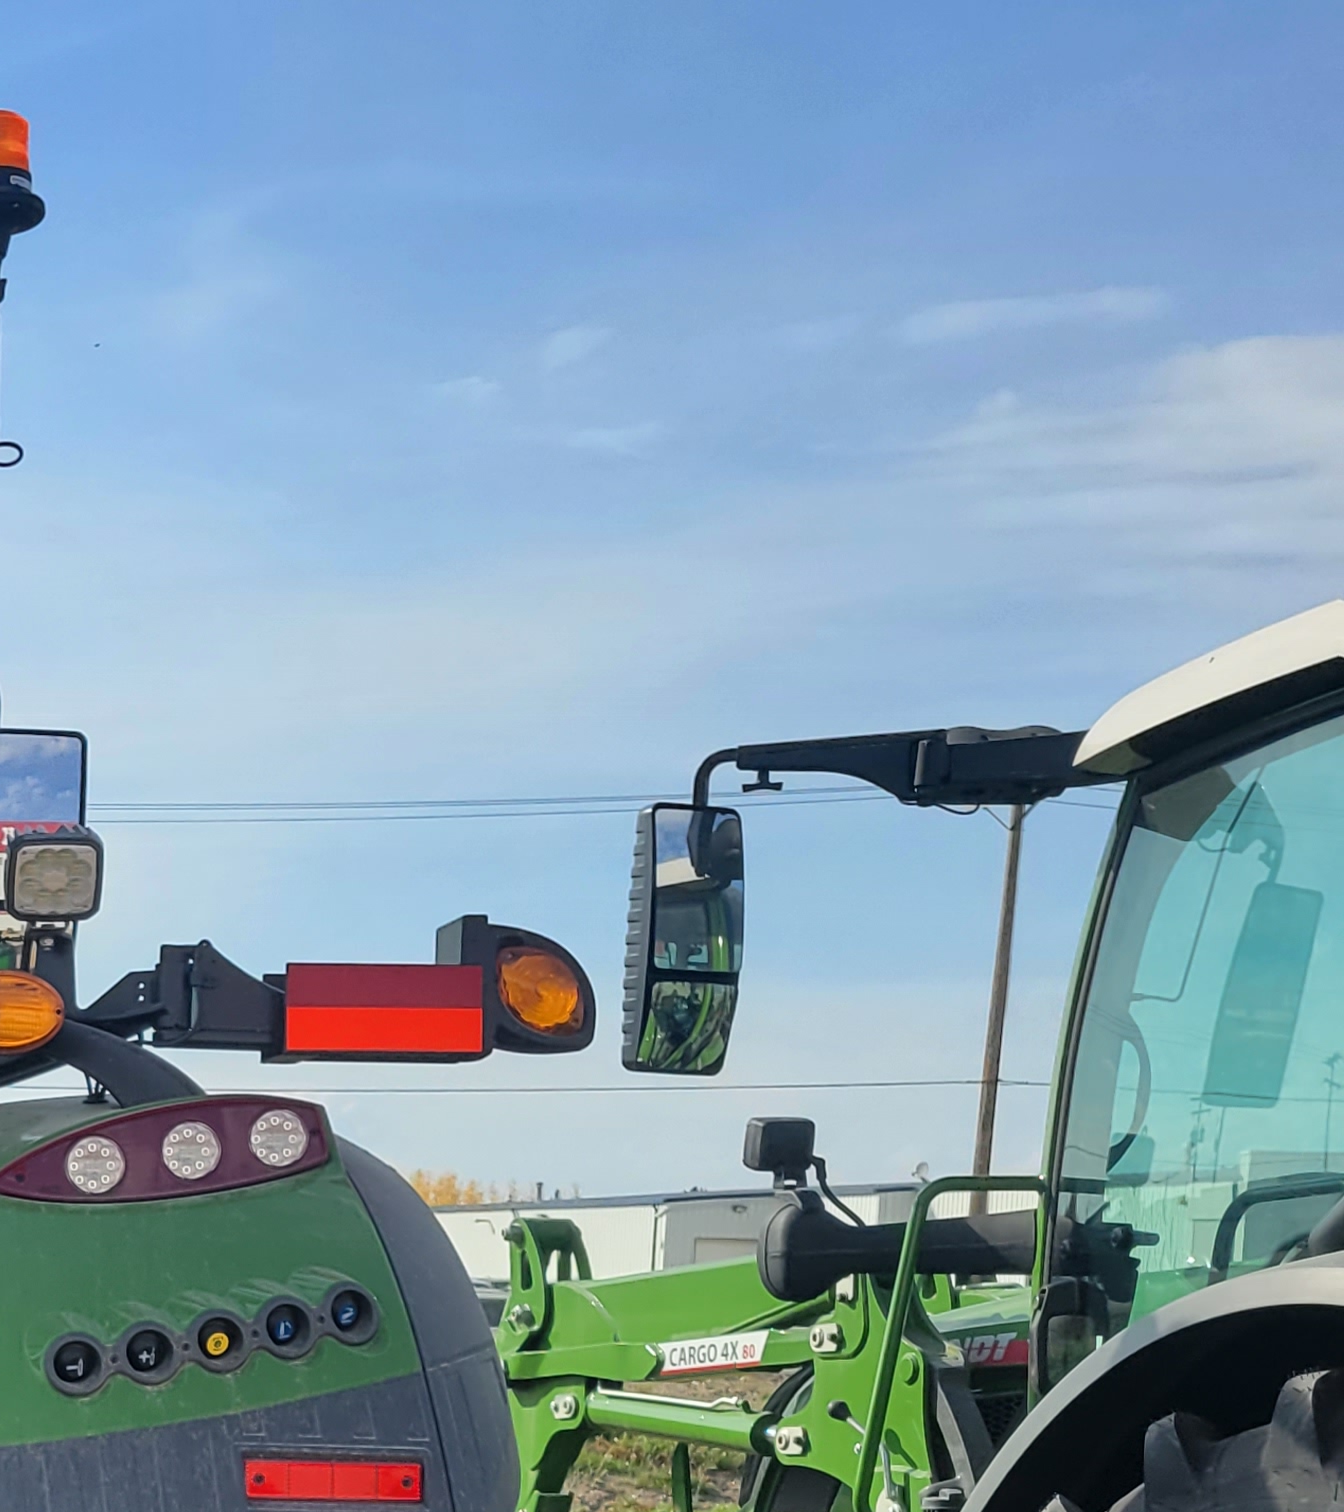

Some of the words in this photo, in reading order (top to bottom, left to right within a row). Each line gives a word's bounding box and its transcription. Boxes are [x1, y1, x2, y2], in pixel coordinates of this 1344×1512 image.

[669, 1344, 718, 1367] CARGO
[721, 1340, 739, 1362] 4X
[742, 1344, 756, 1360] 80
